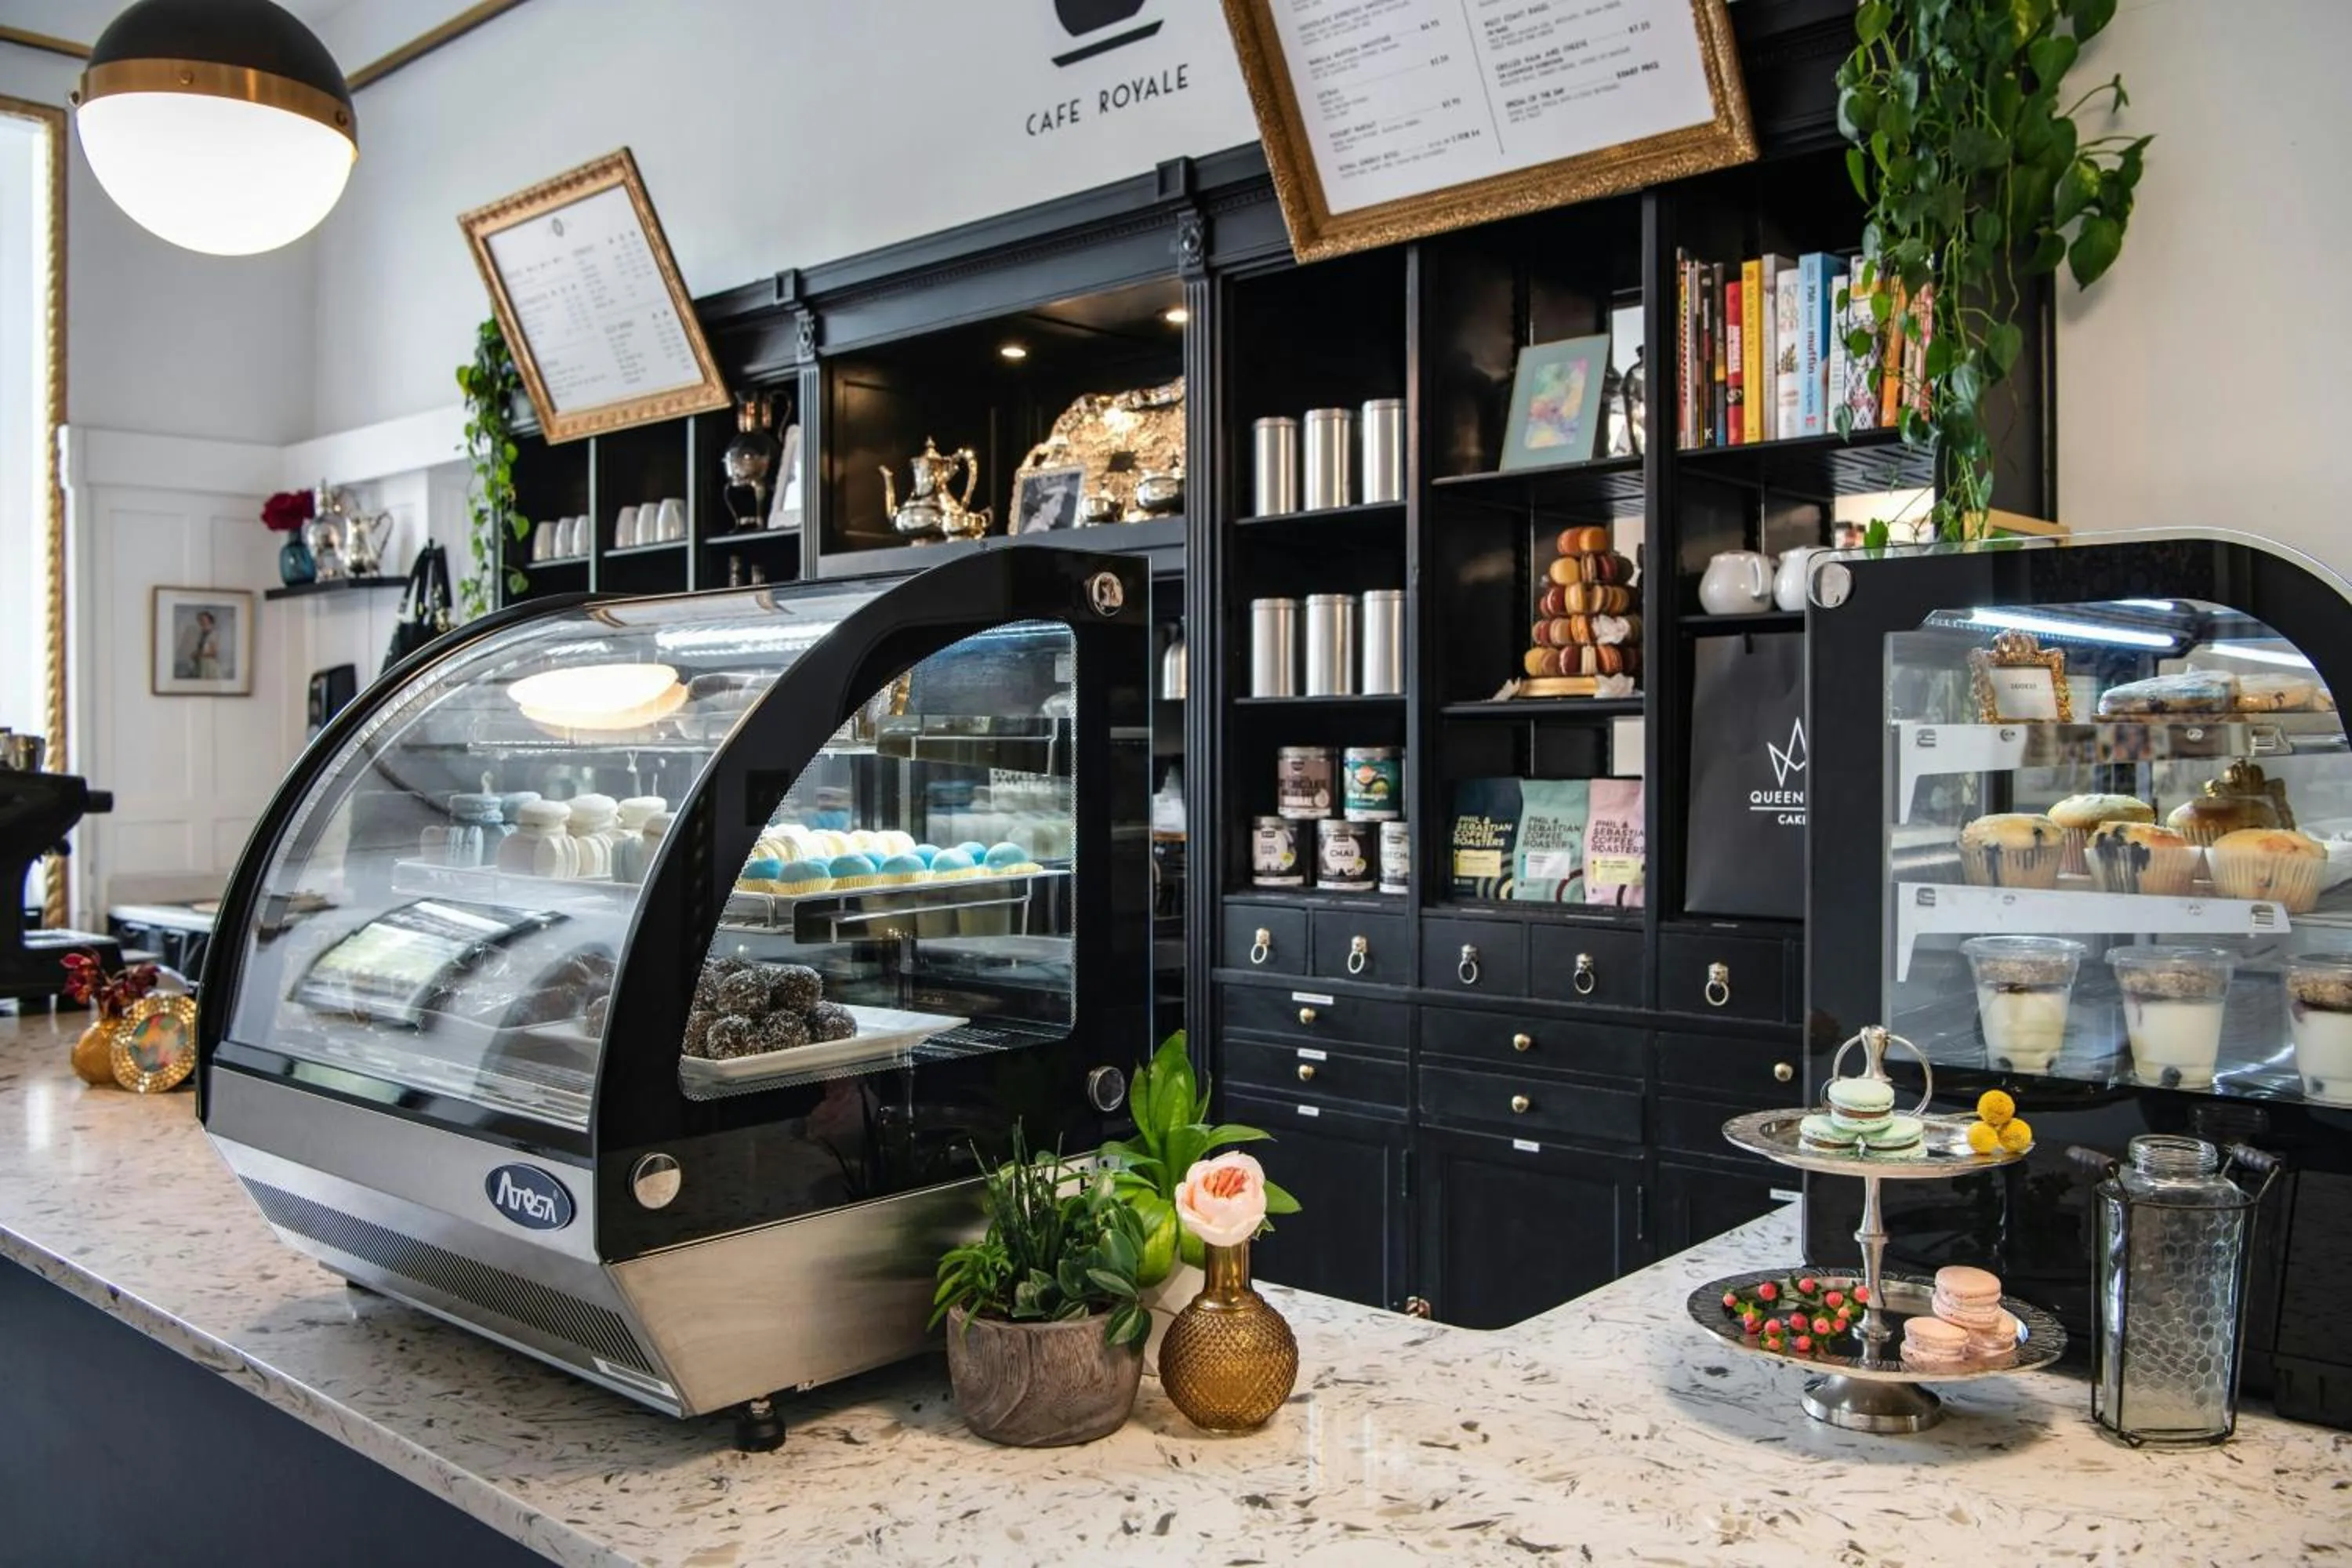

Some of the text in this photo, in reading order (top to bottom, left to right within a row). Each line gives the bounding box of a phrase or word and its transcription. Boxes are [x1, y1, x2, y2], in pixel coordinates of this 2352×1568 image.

[1025, 64, 1189, 136] CAFE ROYALE
[1808, 330, 1817, 374] muffin
[1750, 790, 1804, 804] QUEEN
[1593, 827, 1644, 837] SEBASTIA
[1591, 836, 1633, 846] COFFEE
